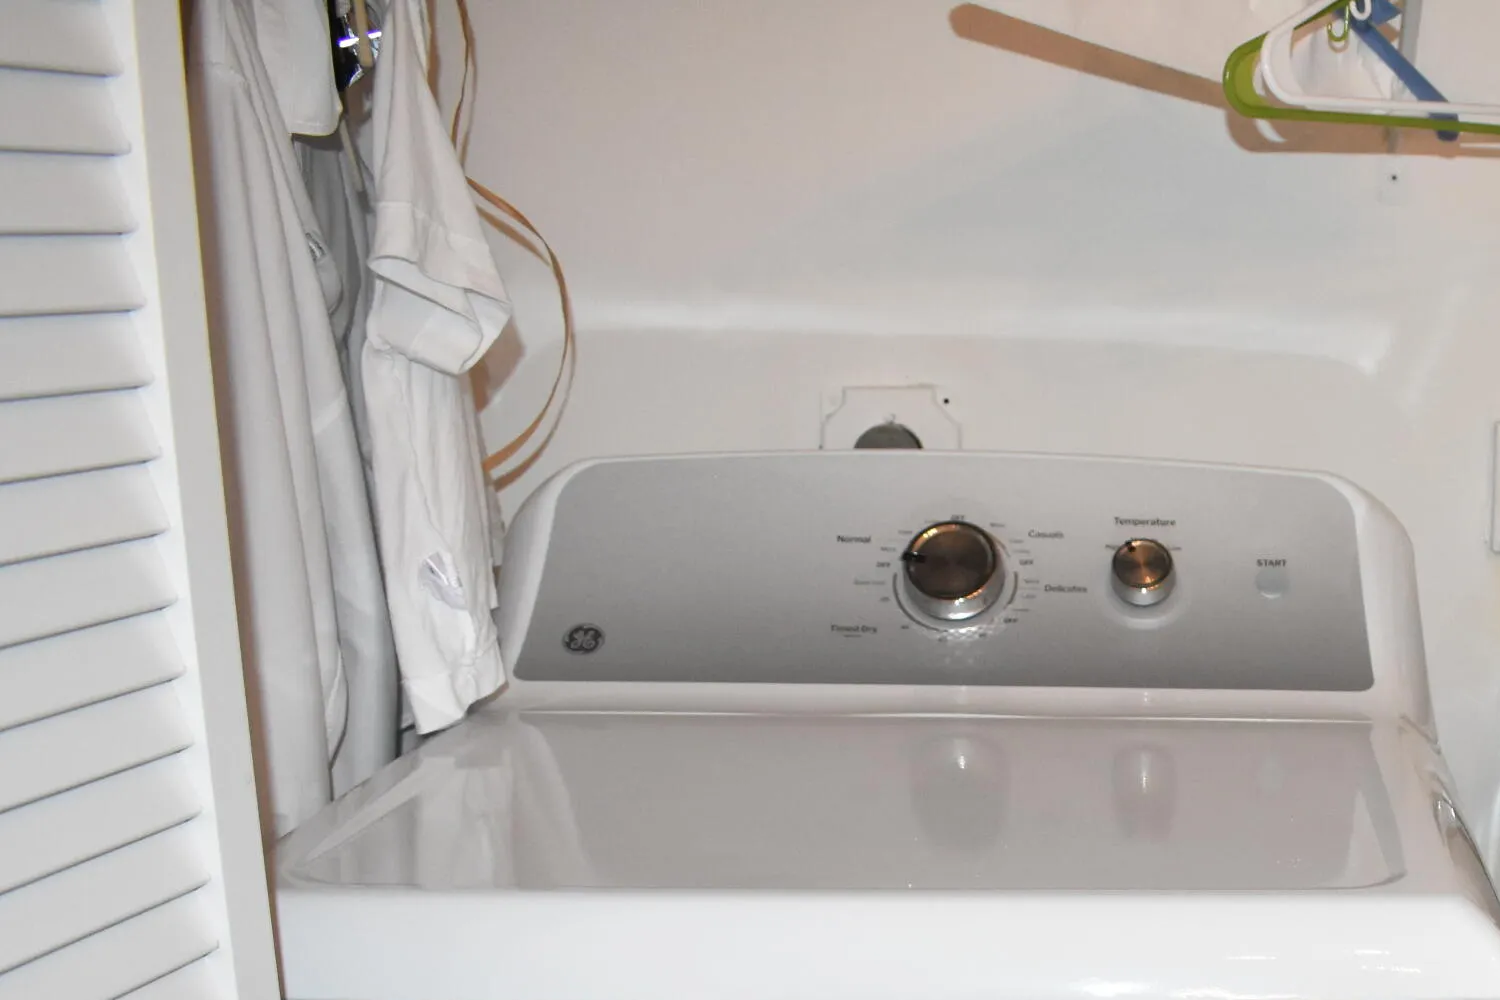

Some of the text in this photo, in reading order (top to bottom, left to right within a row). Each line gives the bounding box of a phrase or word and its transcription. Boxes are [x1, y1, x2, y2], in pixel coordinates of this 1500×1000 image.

[1114, 516, 1176, 527] Temperature
[837, 535, 872, 543] Normal
[1027, 530, 1064, 539] Casuals
[1256, 558, 1288, 567] START
[1044, 584, 1088, 593] Delicates
